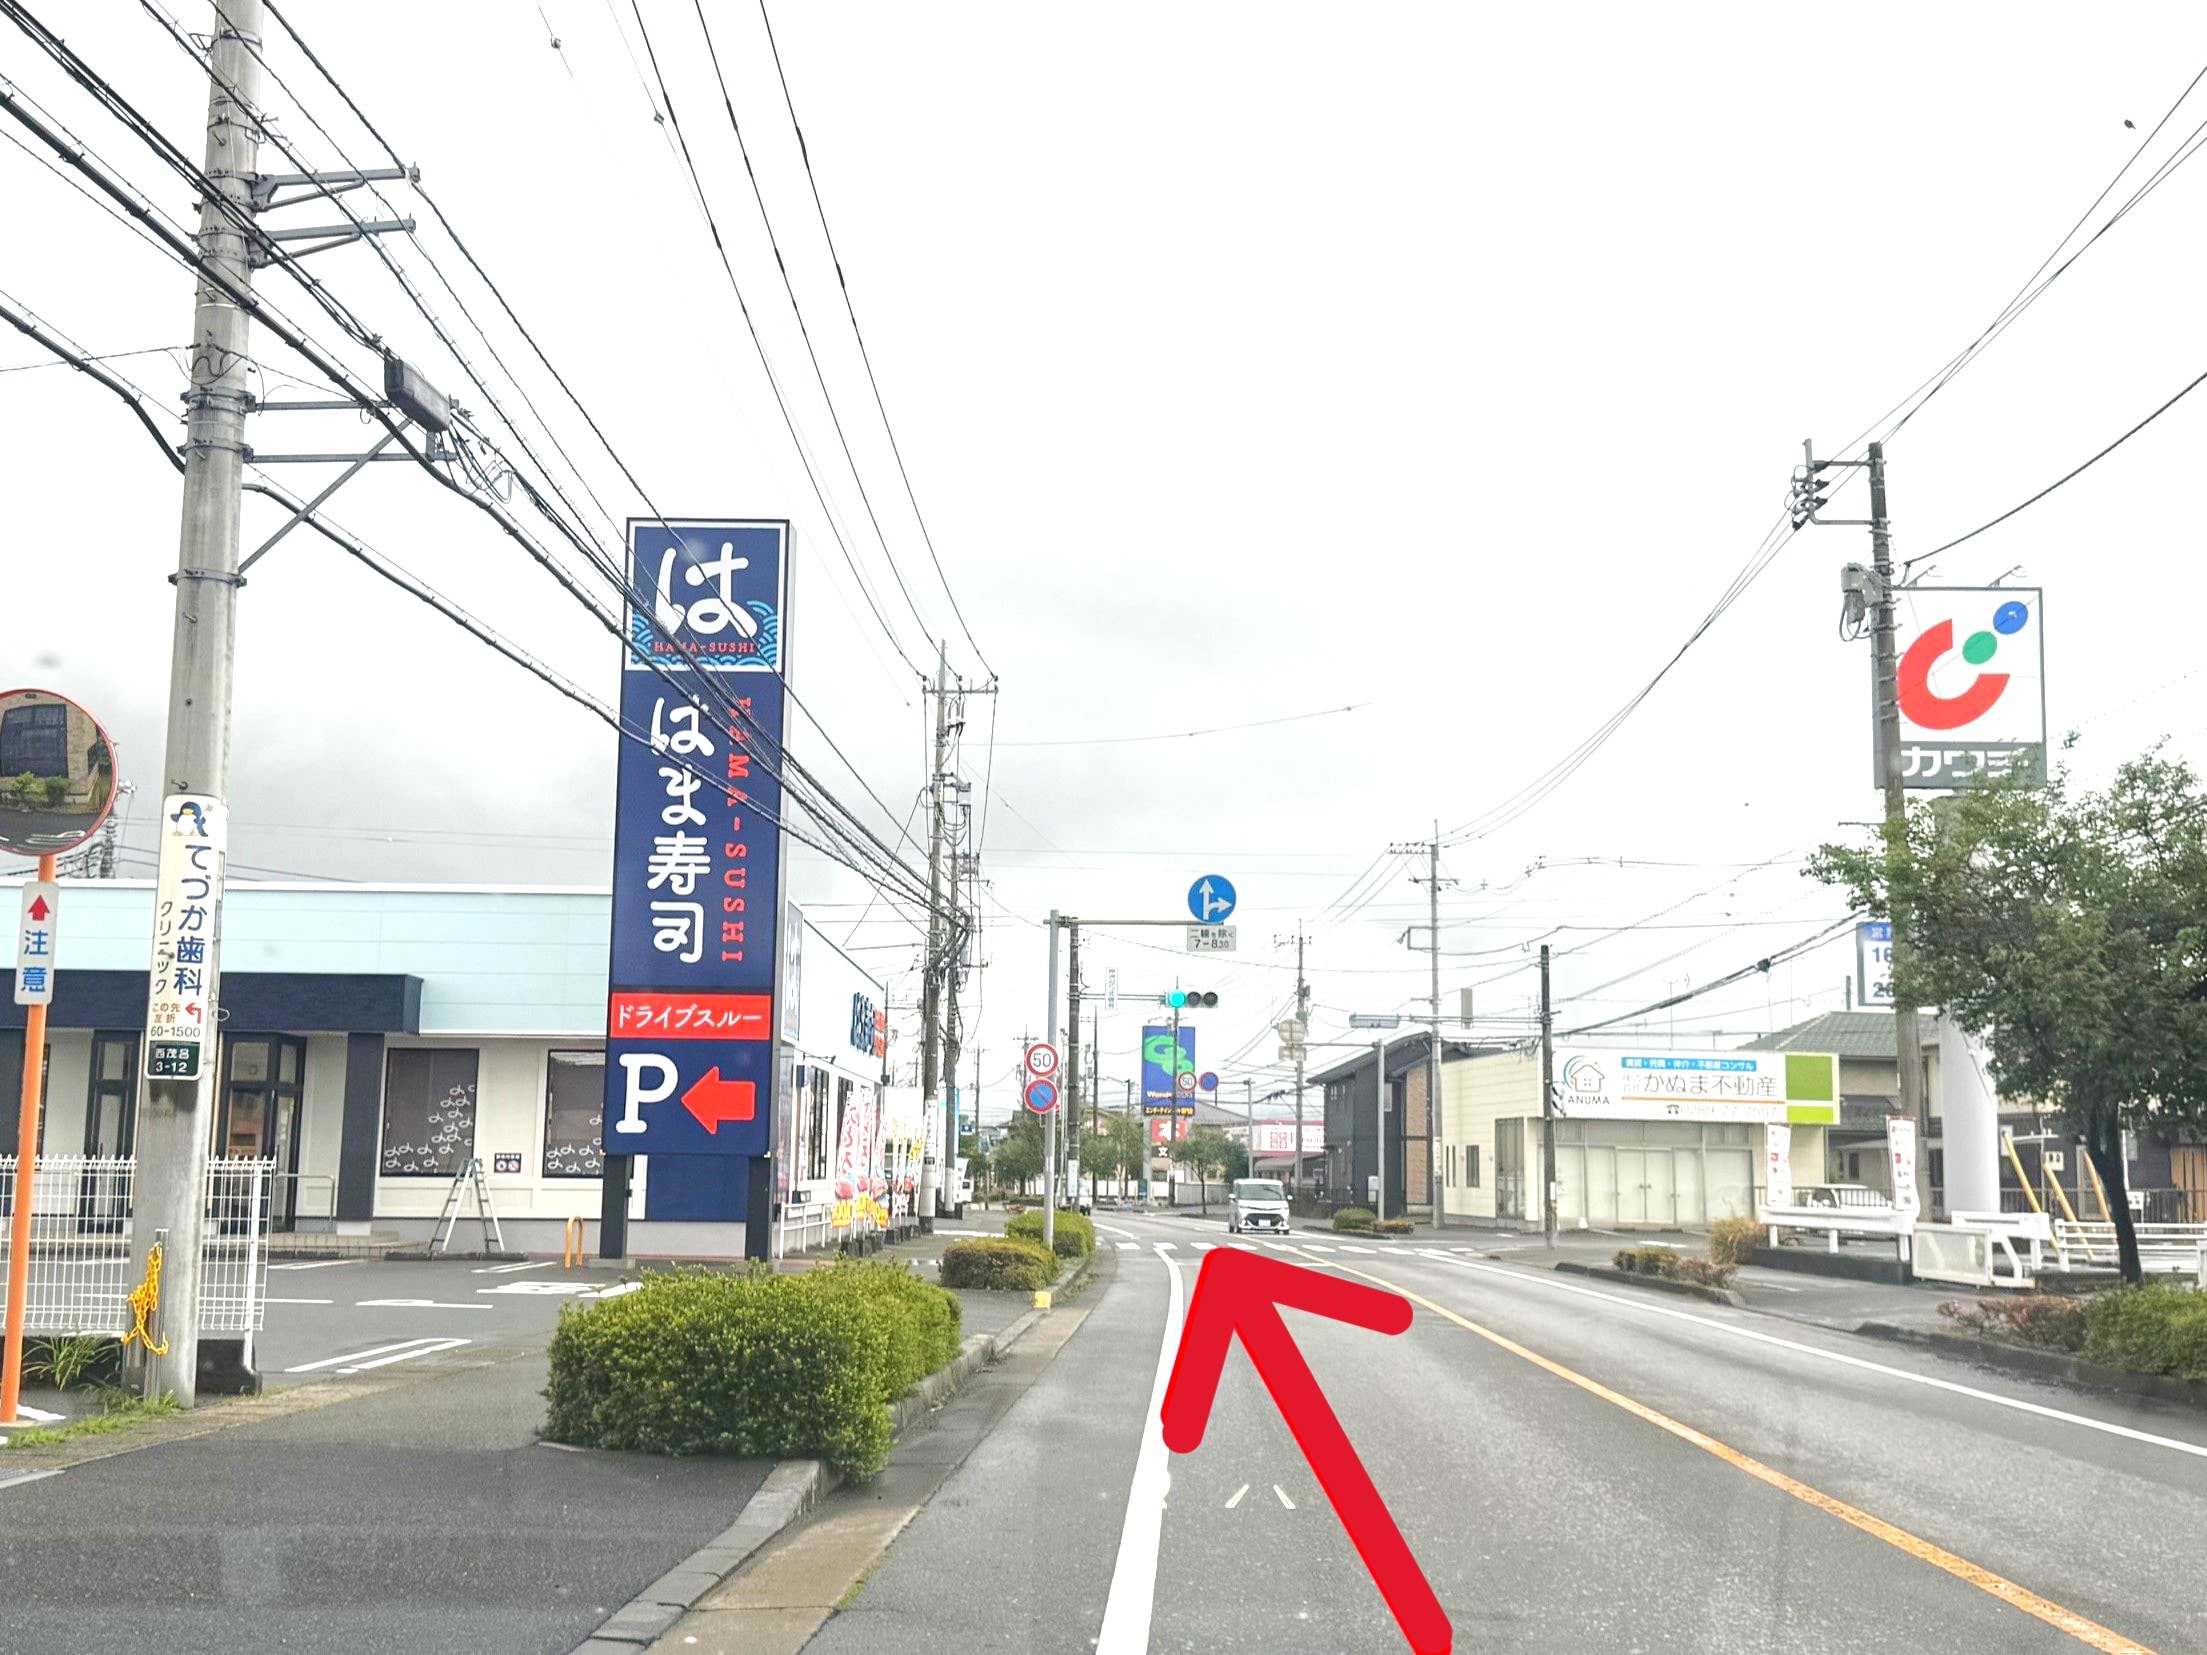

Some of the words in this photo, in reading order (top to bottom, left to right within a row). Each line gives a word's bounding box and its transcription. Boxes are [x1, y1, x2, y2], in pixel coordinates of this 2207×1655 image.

[654, 542, 758, 638] は
[647, 694, 714, 964] はま寿司
[155, 901, 174, 995] クリニック
[173, 844, 211, 996] てづか歯科
[21, 929, 49, 993] 注意
[150, 1026, 201, 1037] 60-1500
[619, 1003, 762, 1029] ドライブスルー
[155, 1061, 188, 1073] 3-12
[1033, 1053, 1052, 1068] 50
[1644, 1073, 1777, 1097] かぬま不動産
[615, 1053, 679, 1134] P
